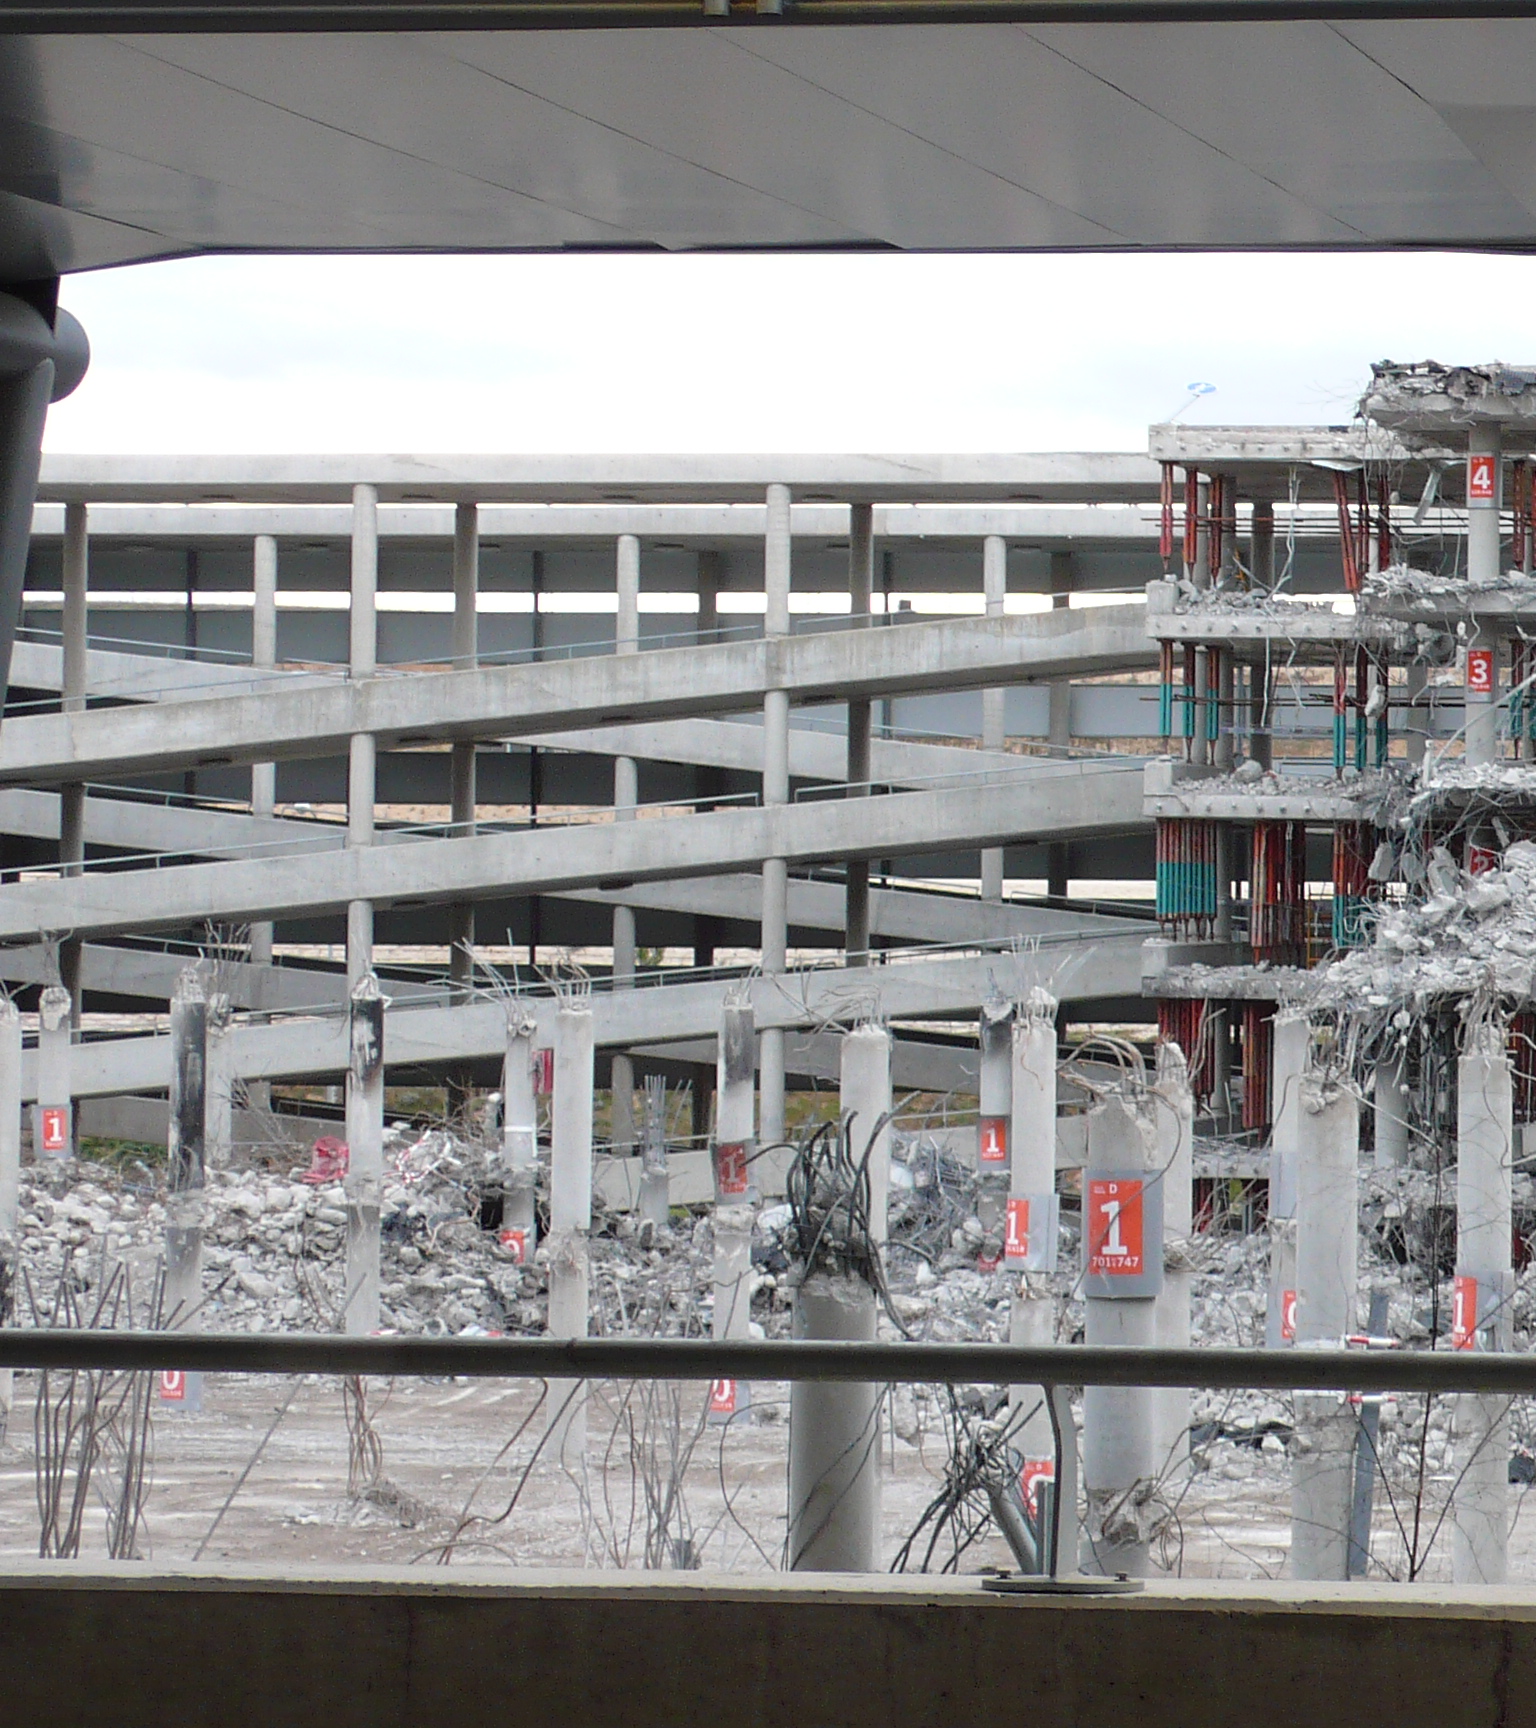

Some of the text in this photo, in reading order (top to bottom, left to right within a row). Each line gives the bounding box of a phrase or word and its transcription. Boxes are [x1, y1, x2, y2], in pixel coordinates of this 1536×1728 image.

[1472, 465, 1491, 490] 4
[1471, 659, 1488, 684] 3
[49, 1117, 62, 1142] 1
[986, 1127, 1000, 1153] 1
[725, 1155, 740, 1184] 1
[1109, 1184, 1118, 1194] D
[1007, 1211, 1019, 1245] 1
[1100, 1200, 1128, 1255] 1
[1454, 1292, 1466, 1335] 1
